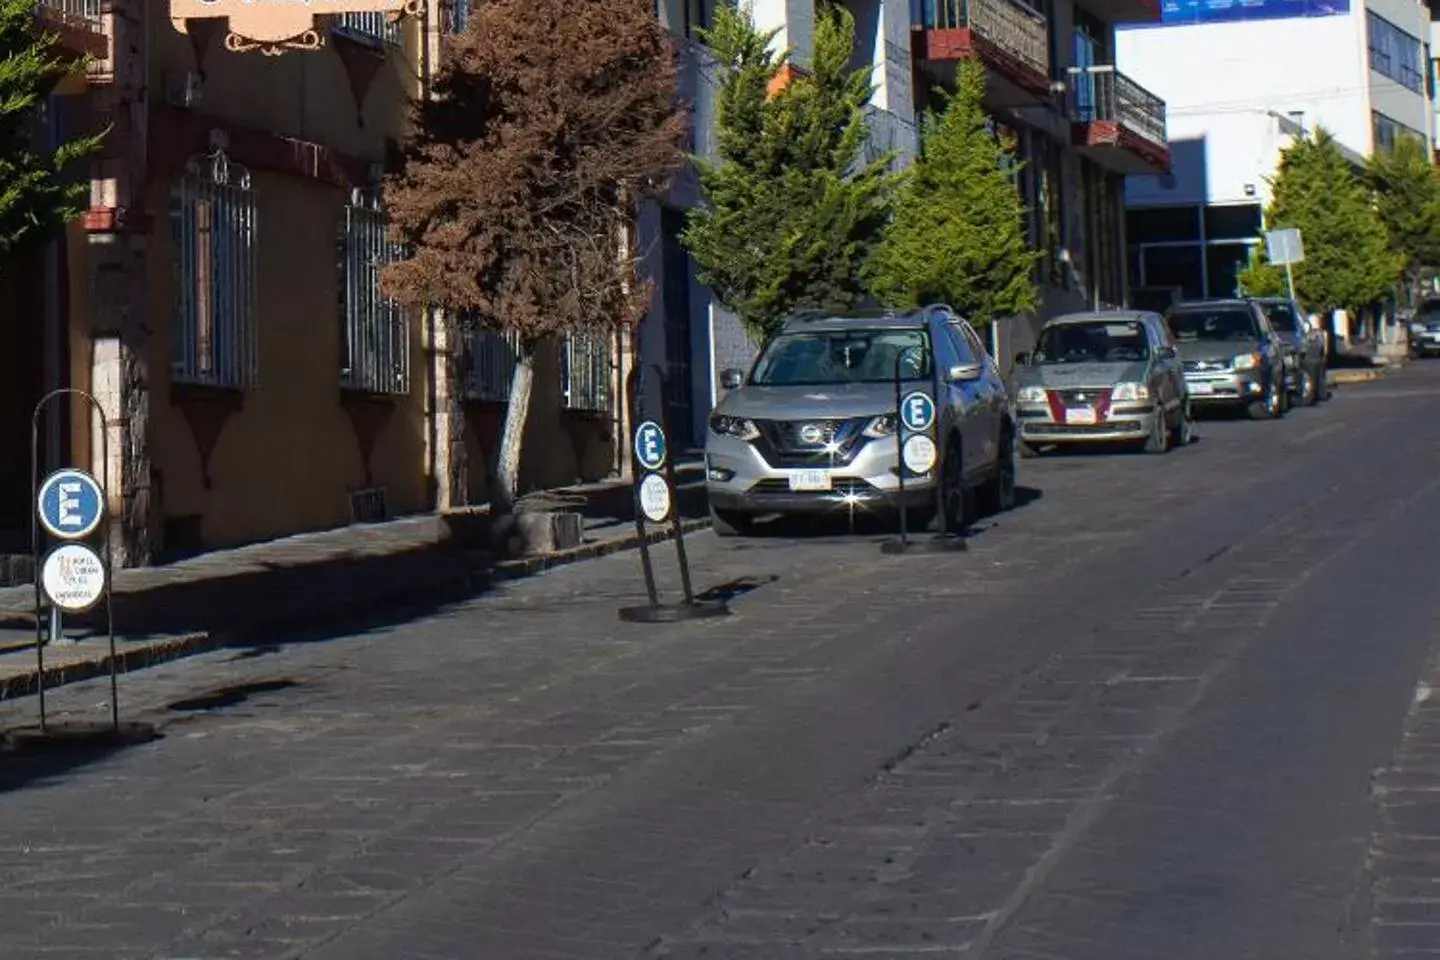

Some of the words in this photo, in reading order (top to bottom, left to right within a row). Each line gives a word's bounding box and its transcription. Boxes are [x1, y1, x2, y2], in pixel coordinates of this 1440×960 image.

[910, 398, 925, 425] E
[644, 429, 659, 461] E
[59, 482, 82, 526] E
